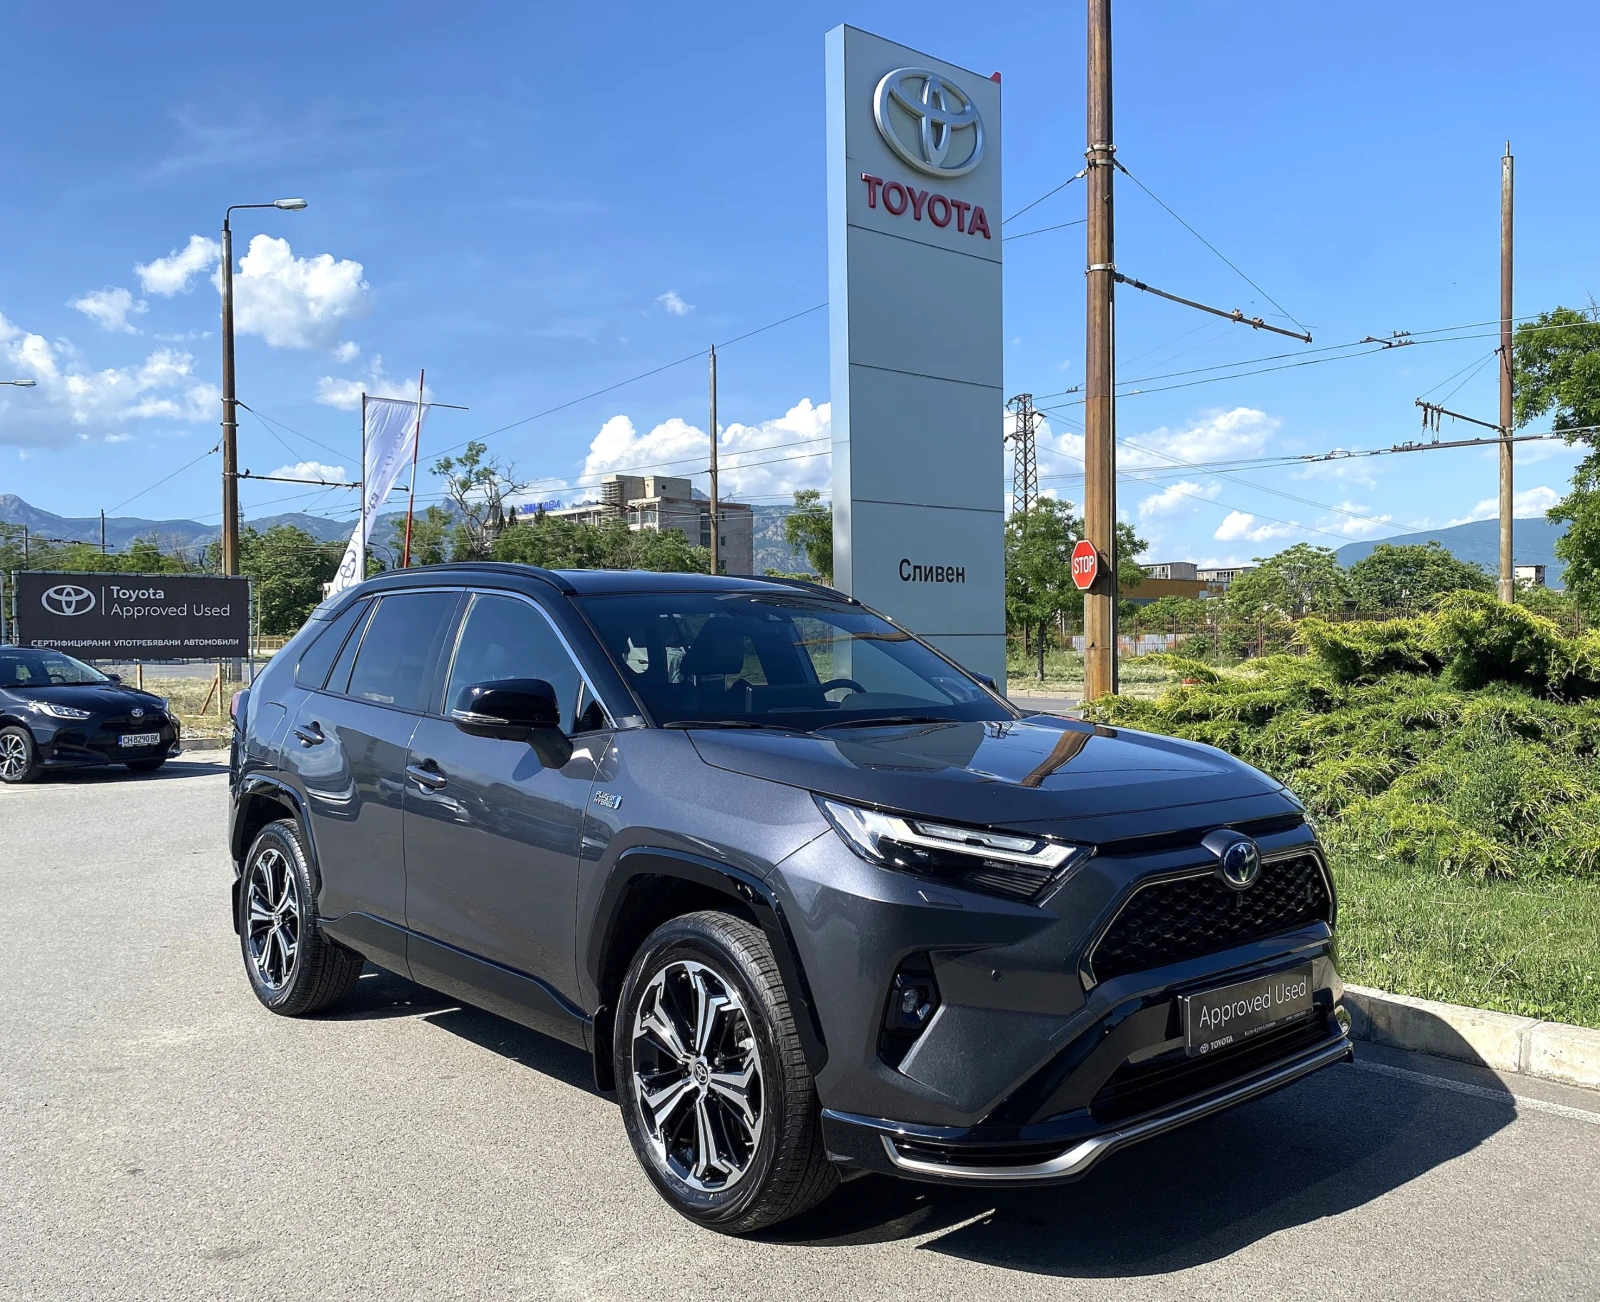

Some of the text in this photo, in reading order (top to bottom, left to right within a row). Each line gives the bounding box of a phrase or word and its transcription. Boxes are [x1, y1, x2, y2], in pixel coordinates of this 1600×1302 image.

[861, 172, 991, 240] TOYOTA
[899, 558, 965, 583] Сливен
[1074, 555, 1094, 574] STOP
[110, 586, 164, 603] Toyota
[110, 603, 230, 619] Approved Used
[31, 638, 239, 648] СЕРТИФИЦИРАНИ УПОТРЕБЯВАНИ АВТОМОБИЛИ
[122, 736, 133, 745] CH
[133, 735, 150, 744] 8290
[150, 734, 159, 743] BK
[1199, 975, 1307, 1030] Approved Used
[1210, 1035, 1233, 1050] TOYOTA
